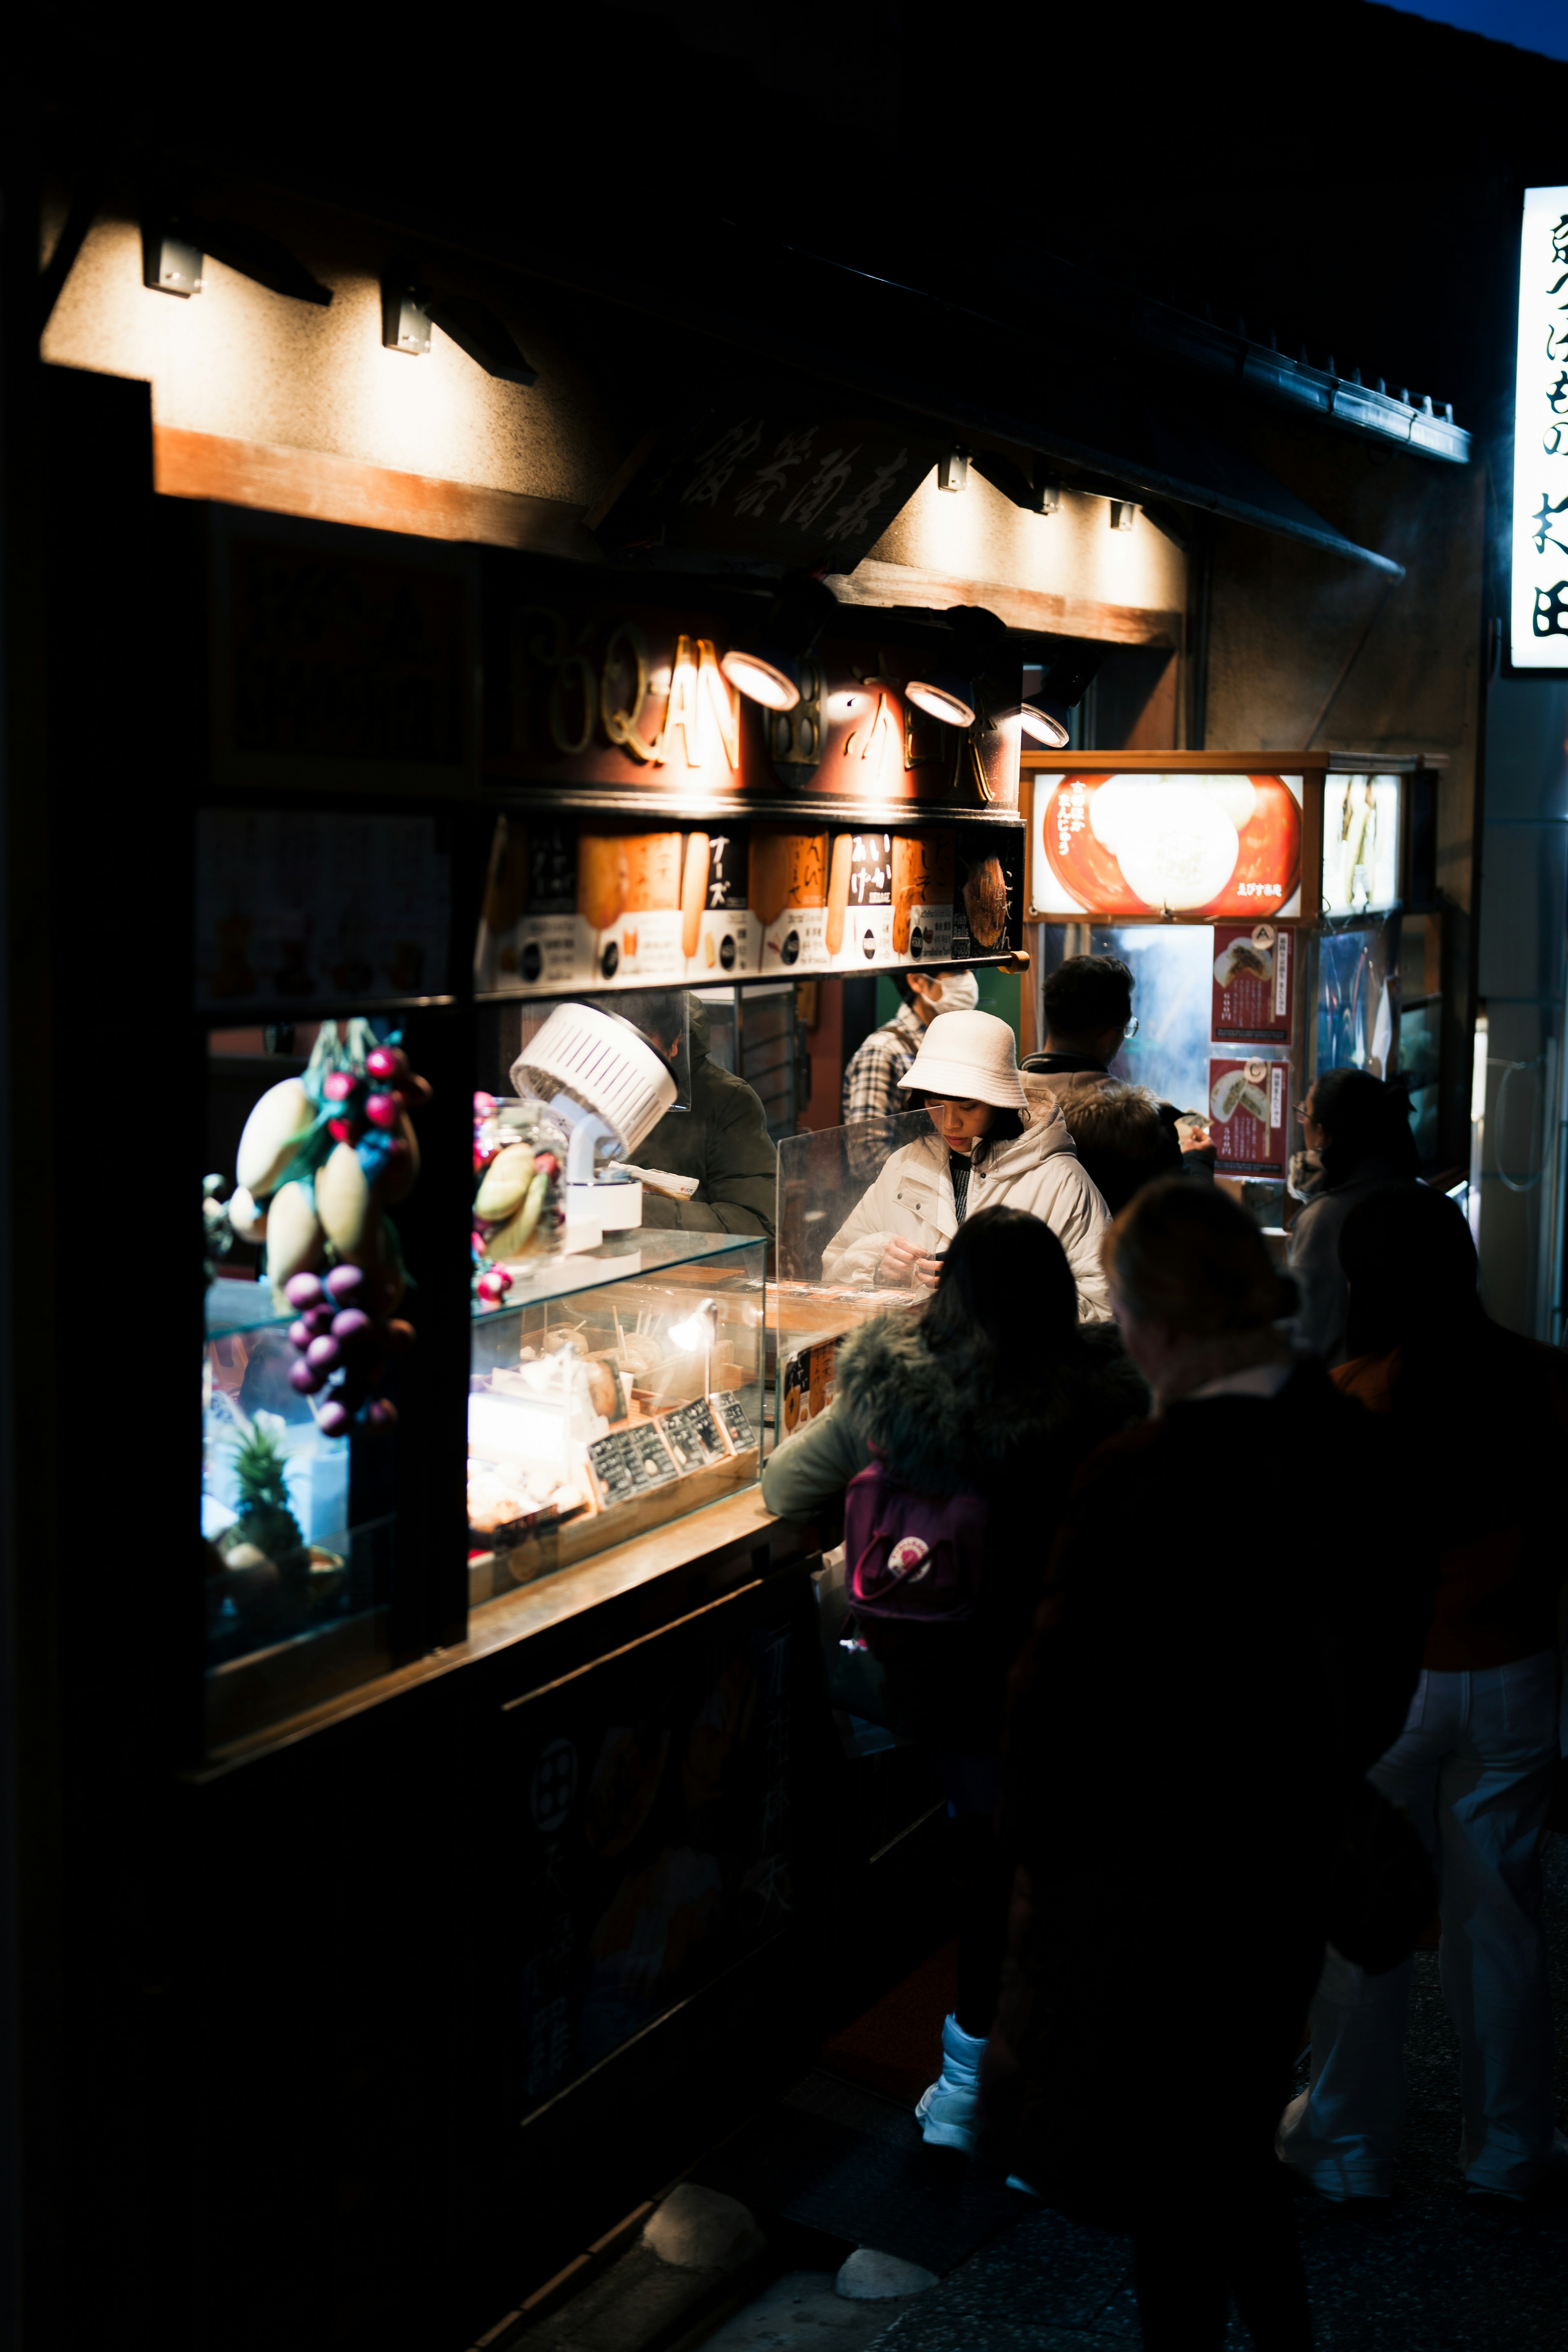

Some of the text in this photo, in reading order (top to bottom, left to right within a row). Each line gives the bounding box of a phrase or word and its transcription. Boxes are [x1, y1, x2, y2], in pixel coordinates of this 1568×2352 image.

[1057, 793, 1071, 856] まんじゅう
[1256, 927, 1270, 939] A
[1250, 1063, 1261, 1076] C
